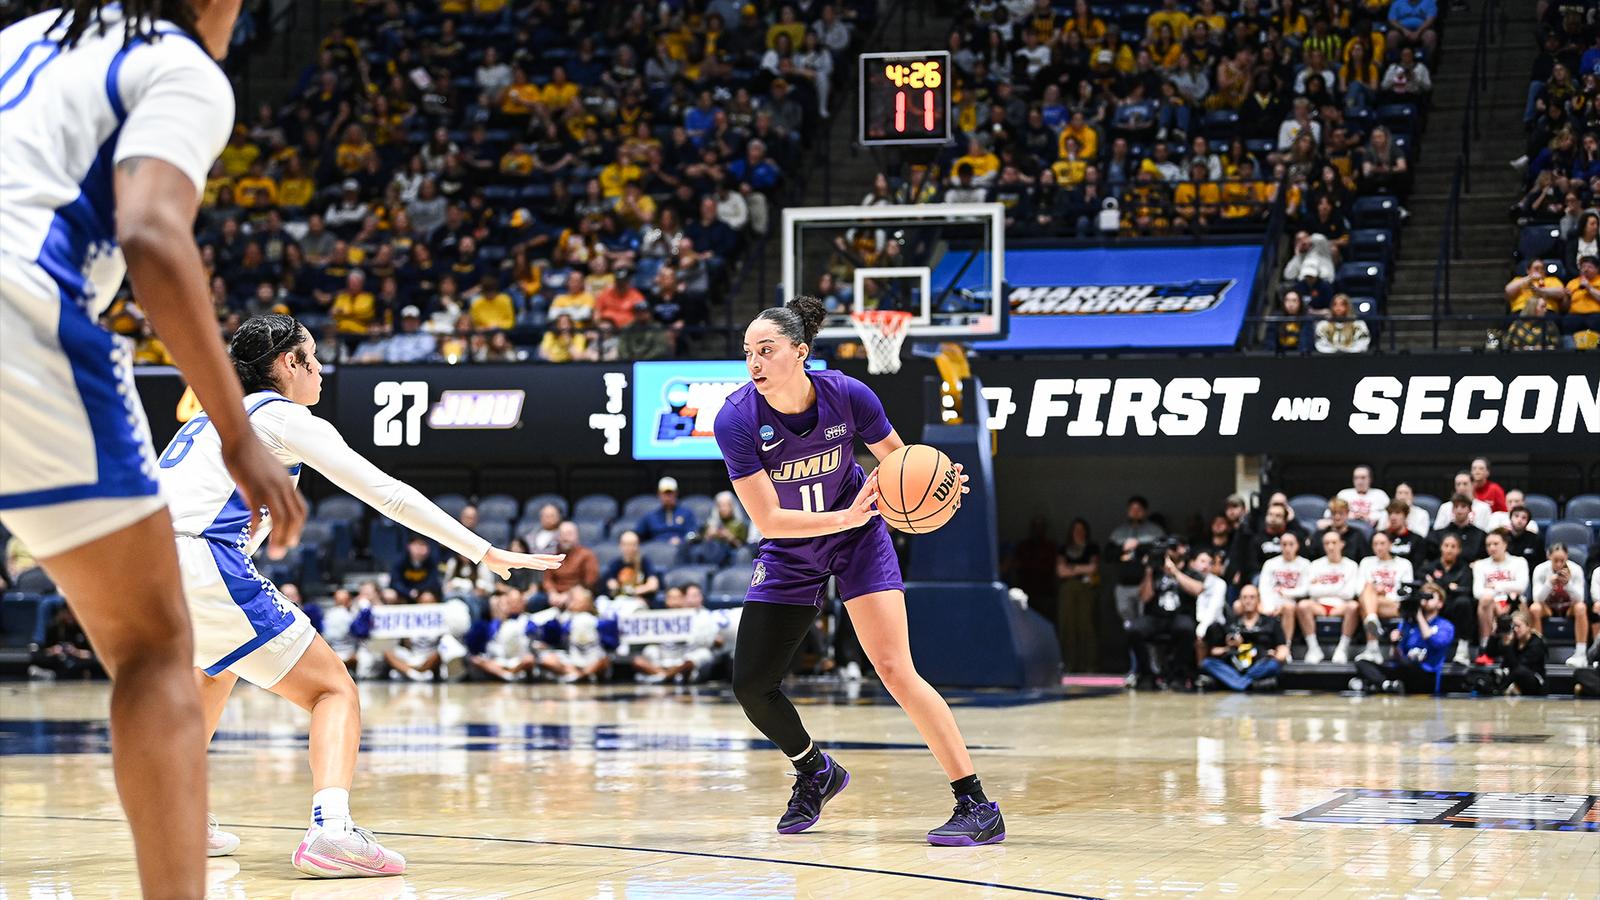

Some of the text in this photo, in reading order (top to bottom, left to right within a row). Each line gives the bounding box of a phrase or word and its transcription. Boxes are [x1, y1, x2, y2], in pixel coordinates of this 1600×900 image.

[885, 61, 941, 88] 4:26
[895, 90, 934, 132] 11
[1008, 285, 1155, 302] MARCH
[1016, 295, 1216, 313] MADNESS
[373, 381, 429, 446] 27
[428, 391, 524, 427] JMU
[1026, 377, 1261, 437] FIRST
[1271, 397, 1331, 421] AND
[1348, 374, 1600, 435] SECON
[159, 416, 210, 468] 8
[772, 448, 840, 480] JMU
[799, 482, 825, 512] 11
[932, 462, 957, 502] Wils
[373, 612, 443, 631] DEFENSE
[621, 615, 692, 636] DEFENSE
